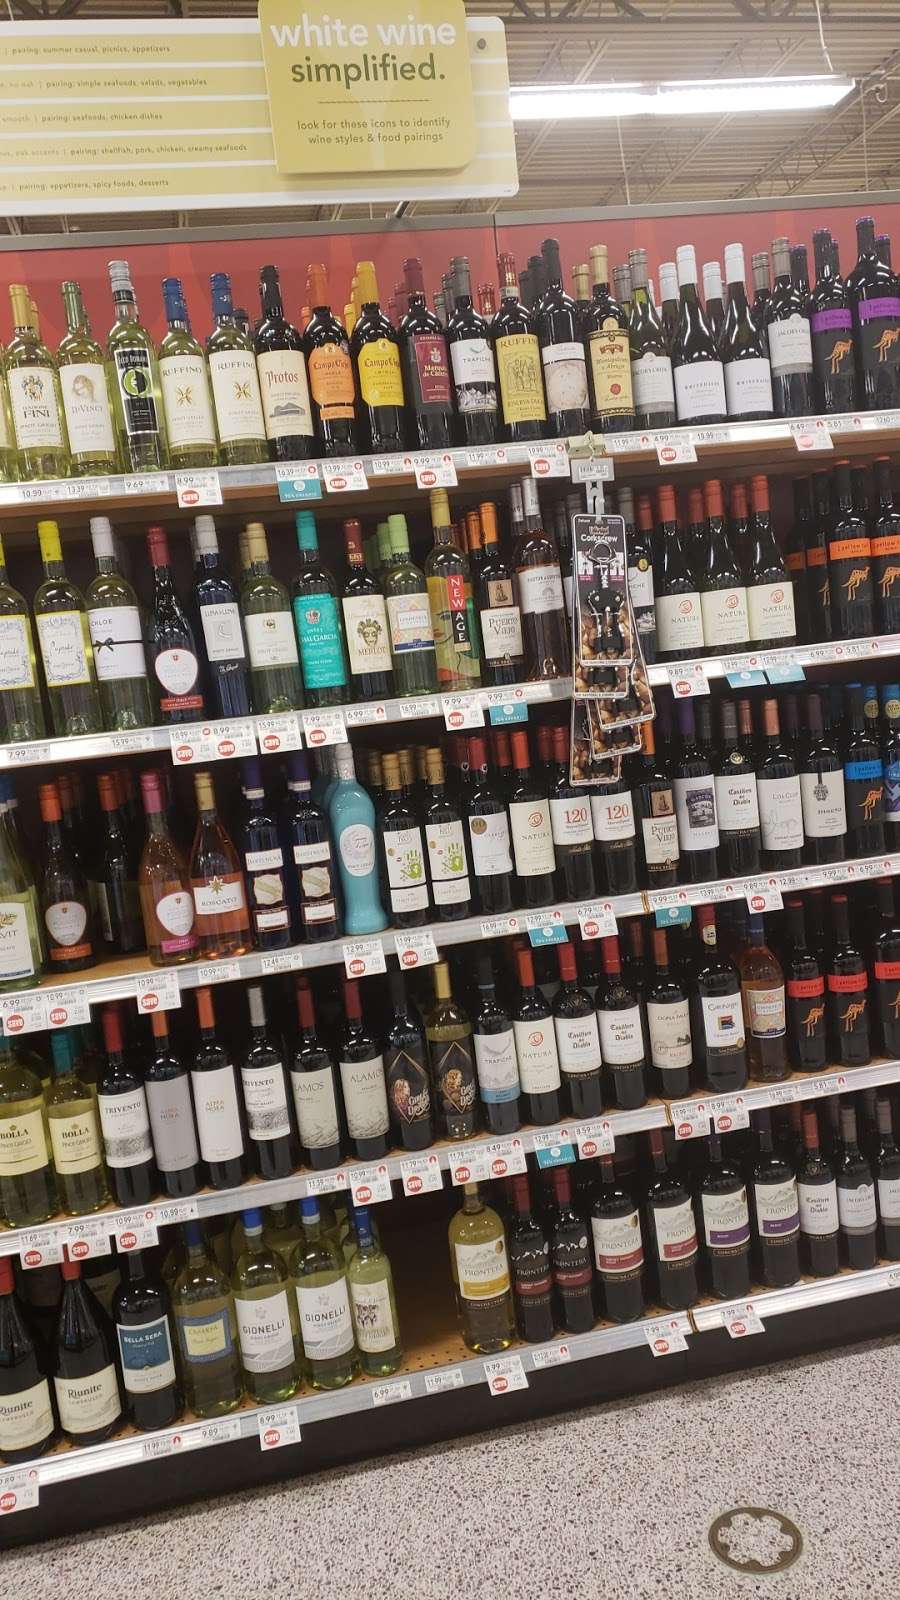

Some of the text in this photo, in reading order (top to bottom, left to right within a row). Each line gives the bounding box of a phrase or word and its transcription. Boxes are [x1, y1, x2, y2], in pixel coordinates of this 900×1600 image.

[270, 14, 457, 48] white wine
[291, 53, 446, 89] simplified.
[78, 80, 101, 88] simple
[168, 79, 207, 87] vegetables
[73, 114, 108, 122] seafoods,
[111, 113, 138, 121] chicken
[297, 118, 451, 130] look for these icons to identify
[308, 132, 443, 145] wine styles & food pairings
[215, 144, 248, 152] seafoods
[50, 182, 90, 190] appetizers,
[93, 181, 111, 189] spicy
[139, 179, 169, 187] desserts
[265, 371, 300, 388] Protos
[24, 409, 51, 420] FINI
[581, 534, 618, 542] Corkscrew
[90, 619, 113, 627] CHLOE
[455, 611, 467, 642] AGE
[358, 647, 386, 657] MERLOT
[564, 808, 587, 824] 120
[606, 804, 629, 820] 120
[105, 1102, 141, 1114] TRIVENTO
[0, 1129, 29, 1138] BOLLA
[62, 1129, 89, 1138] BOLLA
[305, 1305, 346, 1322] GIONELLI
[242, 1319, 285, 1336] GIONELLI
[145, 1331, 163, 1342] SERA
[68, 1384, 103, 1399] Riunite
